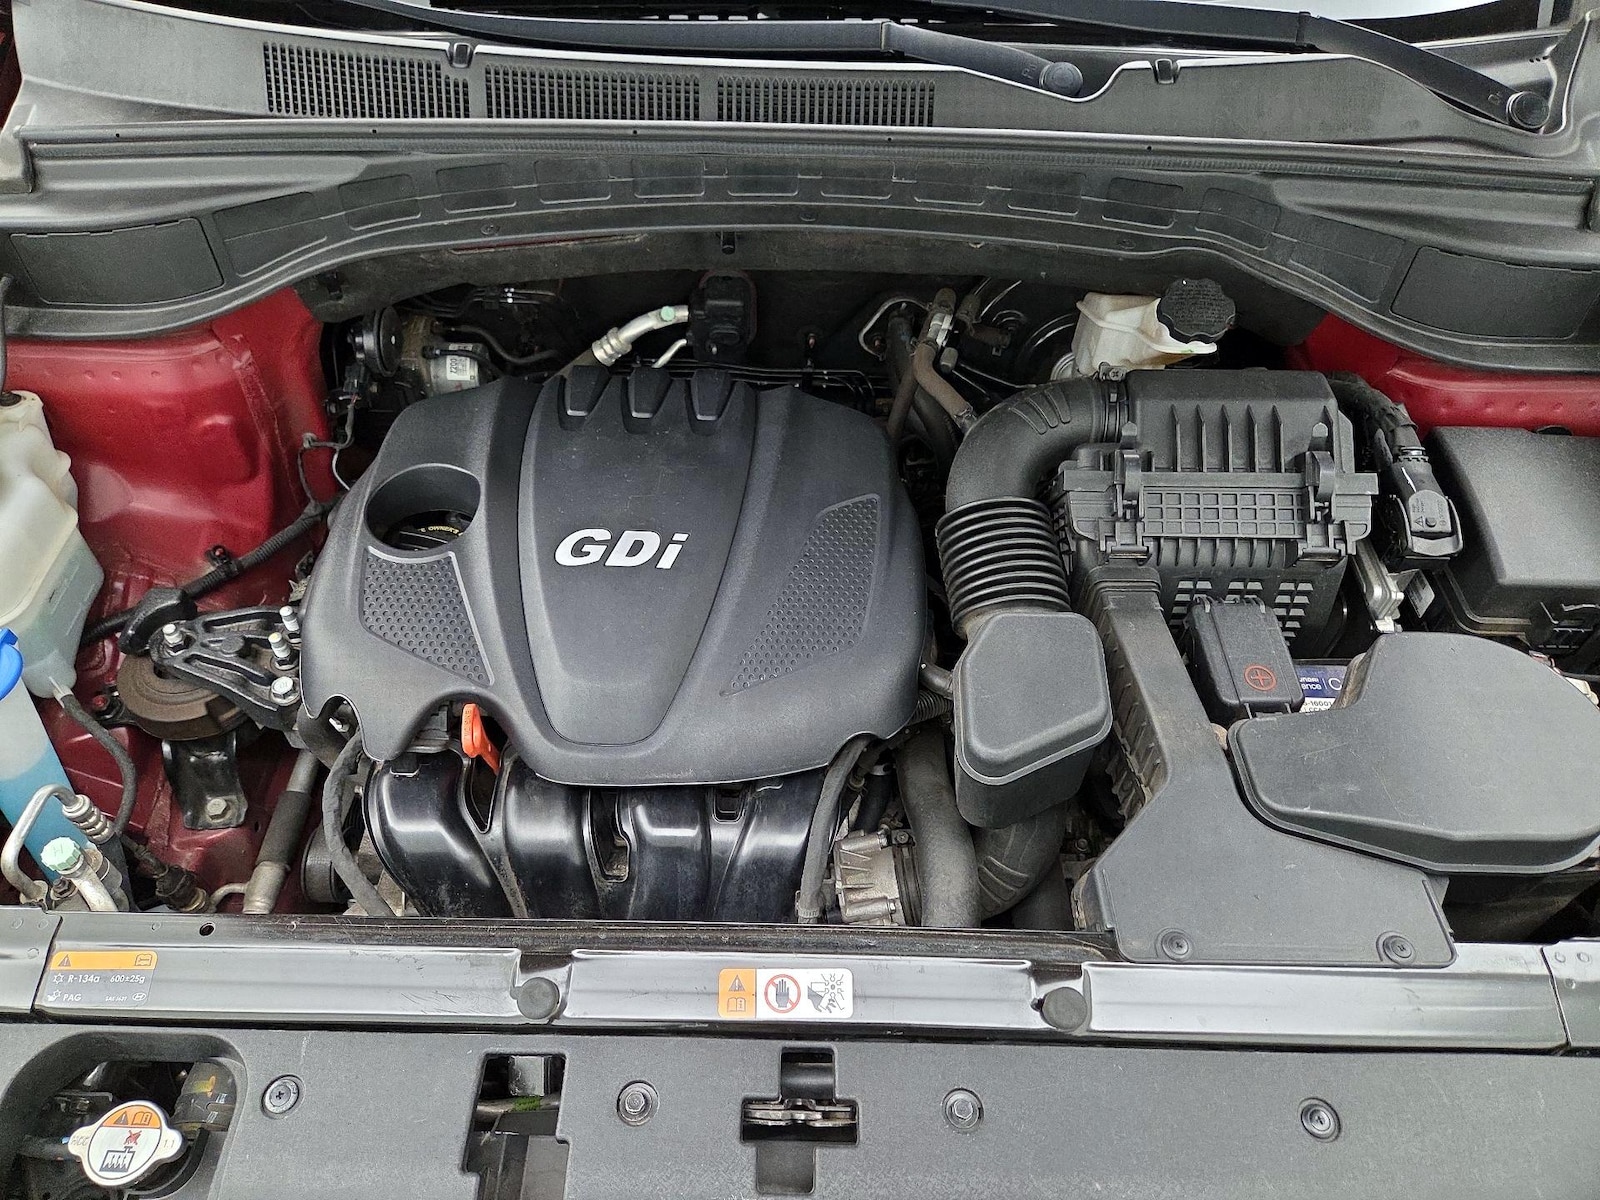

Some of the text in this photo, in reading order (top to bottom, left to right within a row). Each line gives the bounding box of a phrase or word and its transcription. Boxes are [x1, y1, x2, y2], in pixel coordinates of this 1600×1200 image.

[554, 528, 690, 570] GDi
[67, 974, 146, 985] R-134a 600±25g
[62, 993, 82, 1002] PAG
